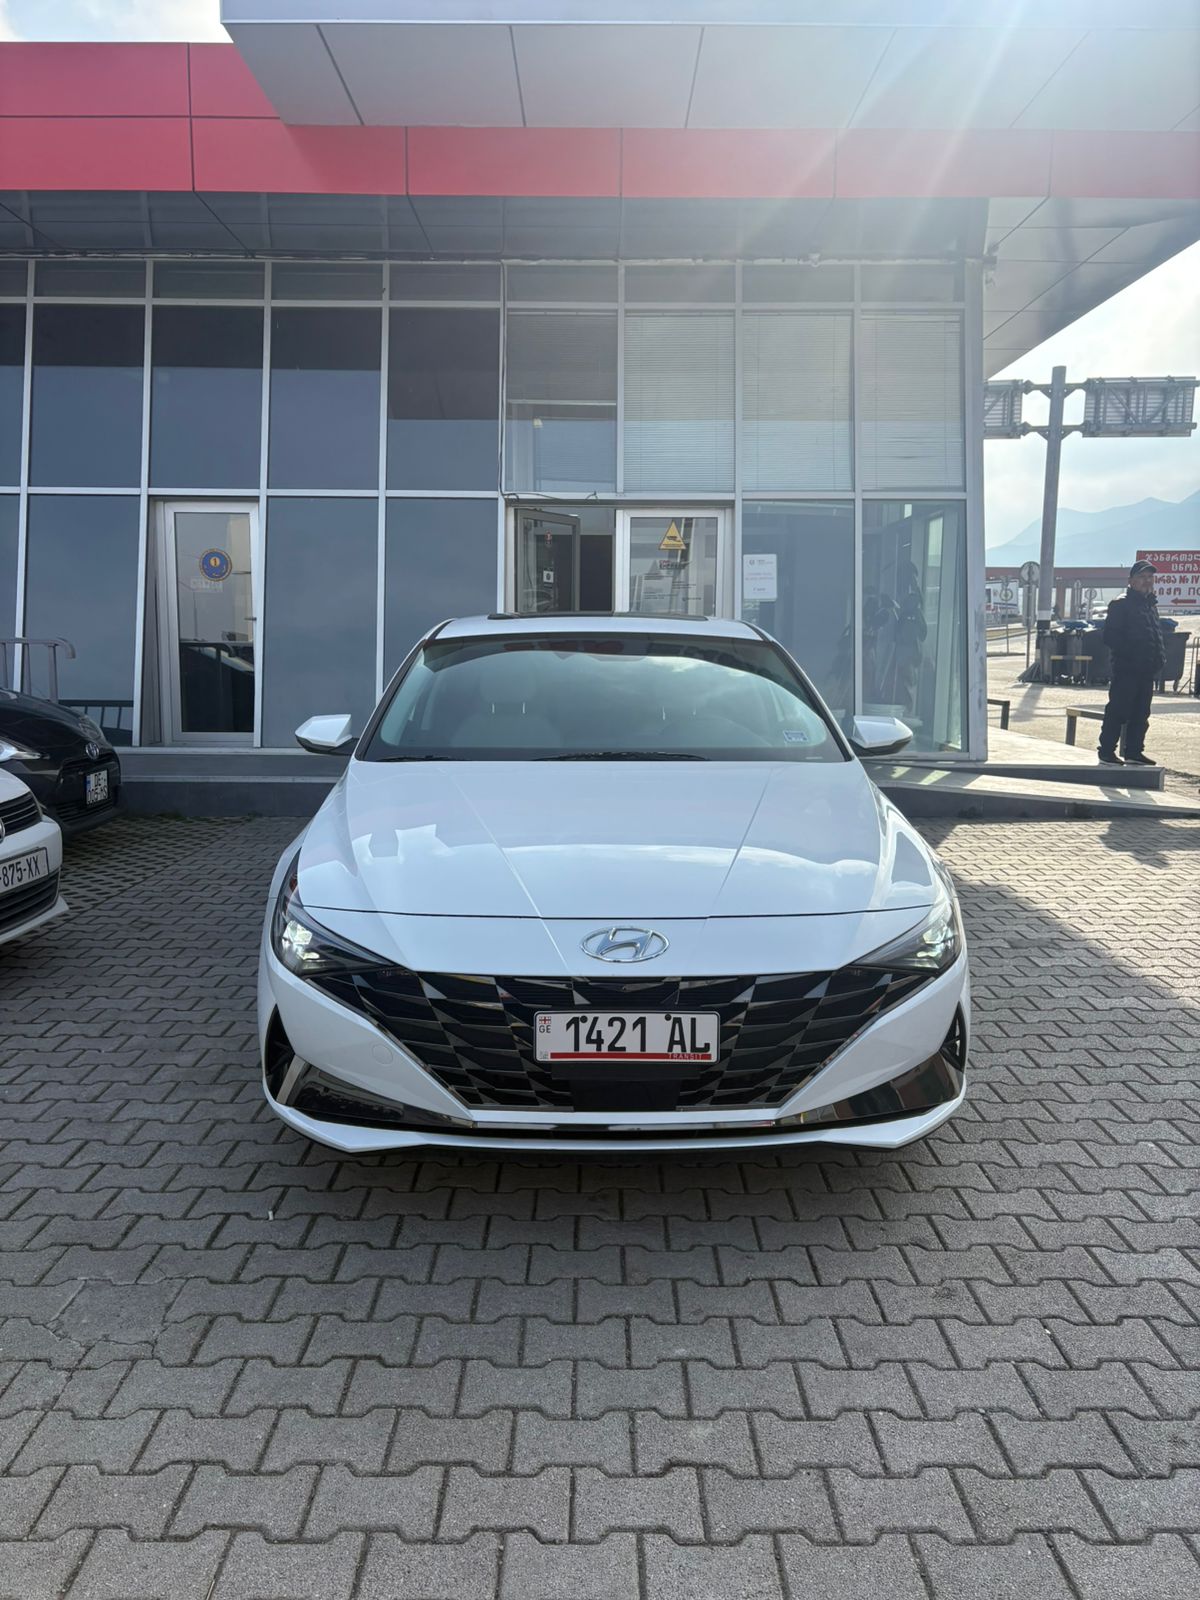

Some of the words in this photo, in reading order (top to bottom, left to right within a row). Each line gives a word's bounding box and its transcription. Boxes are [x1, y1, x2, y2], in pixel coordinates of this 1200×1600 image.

[1171, 563, 1200, 571] ცნობ
[538, 1025, 551, 1034] GE
[566, 1016, 647, 1052] 1421
[667, 1017, 711, 1053] AL
